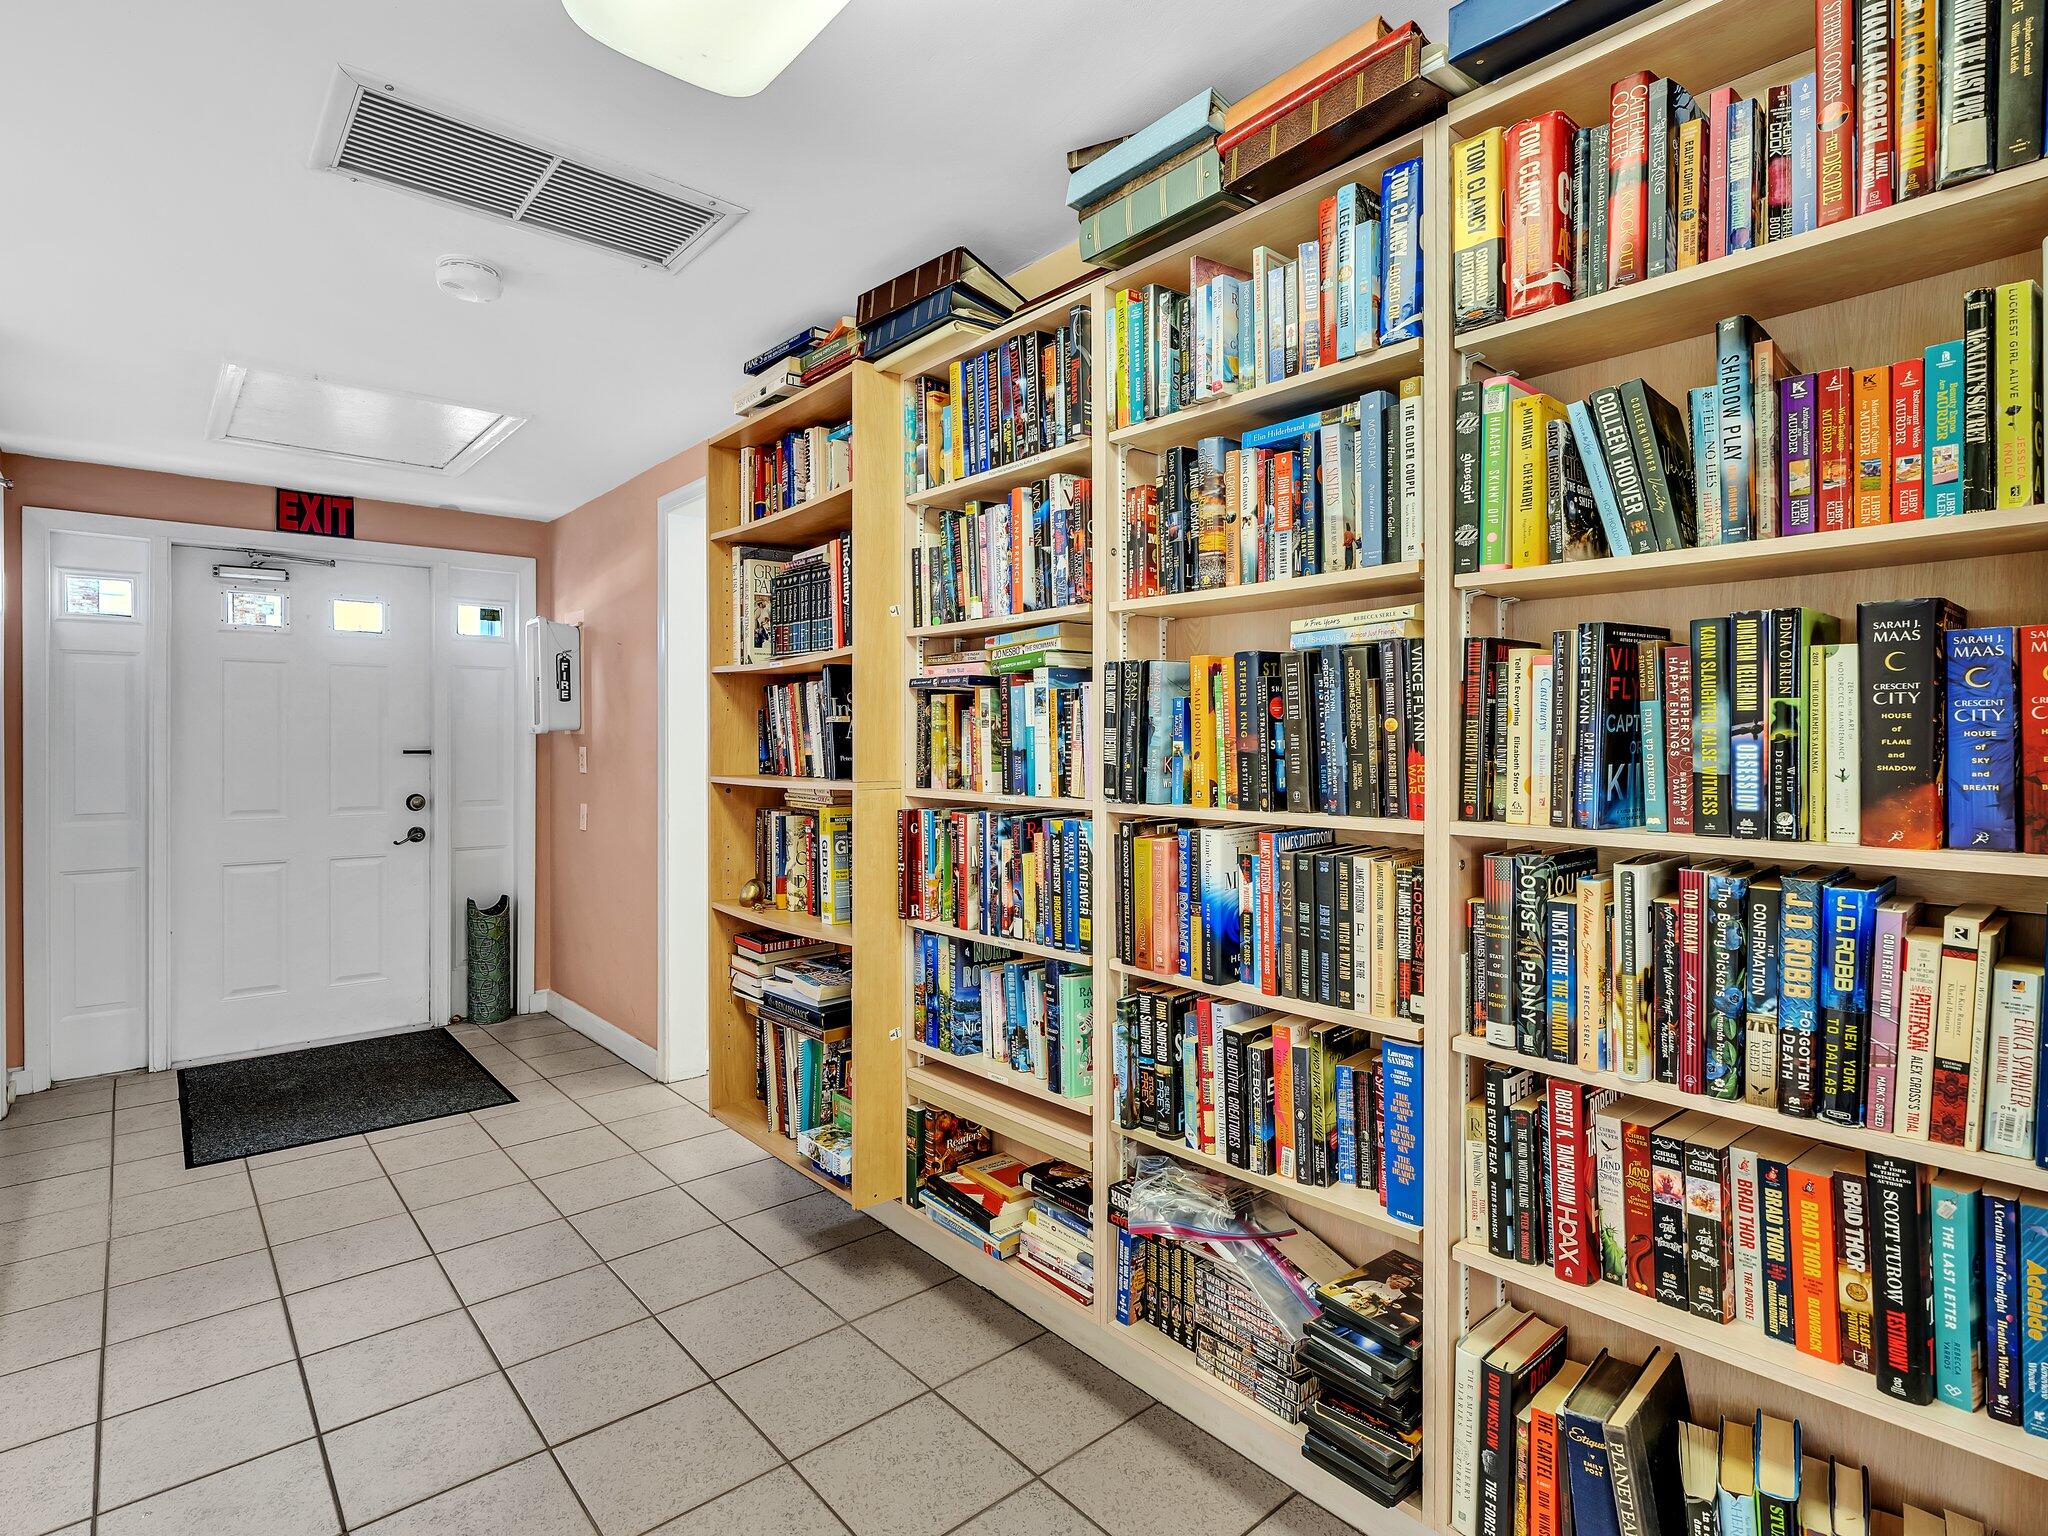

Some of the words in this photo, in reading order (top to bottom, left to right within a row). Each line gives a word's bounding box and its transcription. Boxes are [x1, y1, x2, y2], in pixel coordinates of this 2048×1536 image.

[1823, 1, 1843, 51] STEPHEN
[1611, 91, 1629, 170] COULTER
[1629, 85, 1647, 158] CATHERINE
[1467, 139, 1486, 176] TOM
[1573, 137, 1584, 171] Carol
[1826, 132, 1839, 154] THE
[1390, 167, 1409, 197] TOM
[1573, 173, 1584, 204] Higgins
[1822, 155, 1842, 206] DISCIPLE
[1467, 177, 1487, 234] CLANCY
[1572, 206, 1583, 232] Clark
[1620, 189, 1633, 238] KNOCK
[1390, 203, 1408, 258] CLANCY
[1476, 248, 1489, 301] COMMAND
[1620, 241, 1634, 272] OUT
[1461, 251, 1475, 308] AUTHORITY
[2008, 288, 2018, 337] LUCKIEST
[1027, 345, 1036, 376] DAVID
[2008, 340, 2019, 364] GIRL
[1027, 378, 1037, 423] BALDACCI
[1721, 354, 1741, 423] SHADOW
[2008, 367, 2019, 399] ALIVE
[1407, 403, 1415, 422] THE
[1896, 397, 1907, 446] MURDER
[1406, 425, 1415, 459] GOLDEN
[1488, 416, 1501, 458] HIAASEN
[1522, 407, 1534, 456] MIDNIGHT
[1724, 426, 1743, 460] PLAY
[1788, 412, 1798, 455] MURDER
[1597, 393, 1627, 454] COLLEEN
[1614, 455, 1644, 516] HOOVER
[2003, 442, 2013, 478] KNOLL
[2016, 436, 2027, 481] JESSICA
[1405, 462, 1415, 498] COUPLE
[1460, 453, 1476, 504] ghostgirl
[1487, 469, 1500, 505] SKINNY
[1521, 464, 1534, 513] CHERNOBYL
[280, 491, 353, 536] EXIT
[1489, 507, 1500, 526] DIP
[1791, 500, 1800, 527] KLEIN
[1800, 499, 1810, 525] LIBBY
[1899, 489, 1909, 516] KLEIN
[1909, 488, 1918, 514] LIBBY
[1700, 625, 1716, 660] KARIN
[1873, 620, 1911, 633] SARAH
[1912, 619, 1921, 631] J.
[1873, 631, 1921, 643] MAAS
[1953, 635, 1994, 649] SARAH
[1996, 633, 2005, 648] J.
[1580, 631, 1592, 679] VINCE
[1953, 645, 2005, 659] MAAS
[561, 662, 570, 699] FIRE
[1240, 660, 1248, 707] STEPHEN
[1668, 656, 1680, 698] HAPPY
[1873, 683, 1921, 695] CRESCENT
[1579, 681, 1591, 724] FLYNN
[1700, 662, 1717, 729] SLAUGHTER
[1872, 692, 1921, 705] CITY
[1954, 698, 2005, 712] CRESCENT
[1240, 712, 1249, 738] KING
[1643, 708, 1653, 731] Vinci
[1669, 702, 1681, 757] ENDINGS
[1881, 712, 1912, 720] HOUSE
[1891, 725, 1902, 734] of
[1954, 708, 2006, 723] CITY
[1963, 729, 1998, 738] HOUSE
[1514, 736, 1522, 771] Elizabeth
[1646, 733, 1655, 748] da
[1700, 730, 1717, 767] FALSE
[1881, 738, 1911, 746] FLAME
[1888, 751, 1905, 760] and
[1975, 743, 1987, 752] of
[1646, 750, 1657, 802] Leonardo
[1736, 744, 1758, 812] OBSESSION
[1876, 764, 1917, 773] SHADOW
[1971, 757, 1990, 766] SKY
[1971, 770, 1990, 779] and
[1513, 773, 1521, 795] Strout
[1701, 768, 1719, 817] WITNESS
[1962, 783, 2000, 793] BREATH
[821, 839, 829, 868] GED
[1520, 865, 1538, 936] LOUISE
[1486, 923, 1511, 931] RODHAM
[1486, 932, 1511, 940] CLINTON
[1551, 910, 1568, 937] NICK
[1489, 953, 1505, 961] STATE
[1491, 963, 1501, 971] OF
[1551, 938, 1568, 978] PETRIE
[1751, 903, 1768, 997] CONFIRMATION
[1783, 937, 1813, 999] ROBB
[1834, 934, 1855, 993] ROBB
[1487, 970, 1509, 980] TERROR
[1520, 959, 1537, 1026] PENNY
[1551, 979, 1568, 1001] THE
[1140, 994, 1152, 1013] JOHN
[1156, 999, 1168, 1018] JOHN
[1140, 1014, 1152, 1056] SANDFORD
[1156, 1018, 1168, 1062] SANDFORD
[1550, 1002, 1568, 1056] RUNAWAY
[1827, 1018, 1840, 1037] TO
[1845, 1024, 1858, 1048] NEW
[1387, 1056, 1414, 1069] SANDERS
[1749, 1041, 1758, 1074] REED
[1761, 1041, 1772, 1080] RALPH
[1782, 1031, 1795, 1080] DEATH
[1798, 1009, 1812, 1092] FORGOTTEN
[1824, 1041, 1838, 1095] DALLAS
[1226, 1046, 1239, 1096] BEAUTIFUL
[1844, 1054, 1857, 1094] YORK
[1486, 1082, 1498, 1108] HER
[1553, 1088, 1573, 1130] ROBERT
[1226, 1096, 1240, 1149] CREATURES
[1487, 1110, 1498, 1146] EVERY
[1489, 1148, 1499, 1175] FEAR
[1652, 1155, 1681, 1166] COLFER
[1655, 1149, 1679, 1159] CHRIS
[1554, 1142, 1577, 1206] TANENBAUM
[1738, 1177, 1753, 1211] BRAD
[1763, 1187, 1782, 1223] BRAD
[1843, 1180, 1863, 1227] BRAD
[1396, 1209, 1414, 1221] PUTNAM
[1739, 1213, 1756, 1250] THOR
[1801, 1199, 1820, 1240] BRAD
[1883, 1188, 1900, 1240] SCOTT
[1556, 1207, 1579, 1266] HOAX
[1764, 1224, 1785, 1263] THOR
[1844, 1228, 1866, 1275] THOR
[1943, 1226, 1954, 1248] THE
[1802, 1242, 1822, 1279] THOR
[1884, 1243, 1905, 1307] TUROW
[1944, 1249, 1955, 1277] LAST
[1744, 1289, 1756, 1321] APOSTLE
[1944, 1279, 1957, 1331] LETTER
[2026, 1258, 2048, 1342] Adelaide
[1808, 1297, 1824, 1354] BLOWBACK
[1886, 1309, 1909, 1374] TESTIMONY
[1996, 1318, 2009, 1352] Heather
[1487, 1372, 1500, 1396] DON
[1998, 1353, 2010, 1389] Webber
[1485, 1397, 1499, 1451] WINSLOW
[1536, 1436, 1552, 1481] CARTEL
[1584, 1460, 1604, 1472] EMILY
[1585, 1467, 1603, 1478] POST
